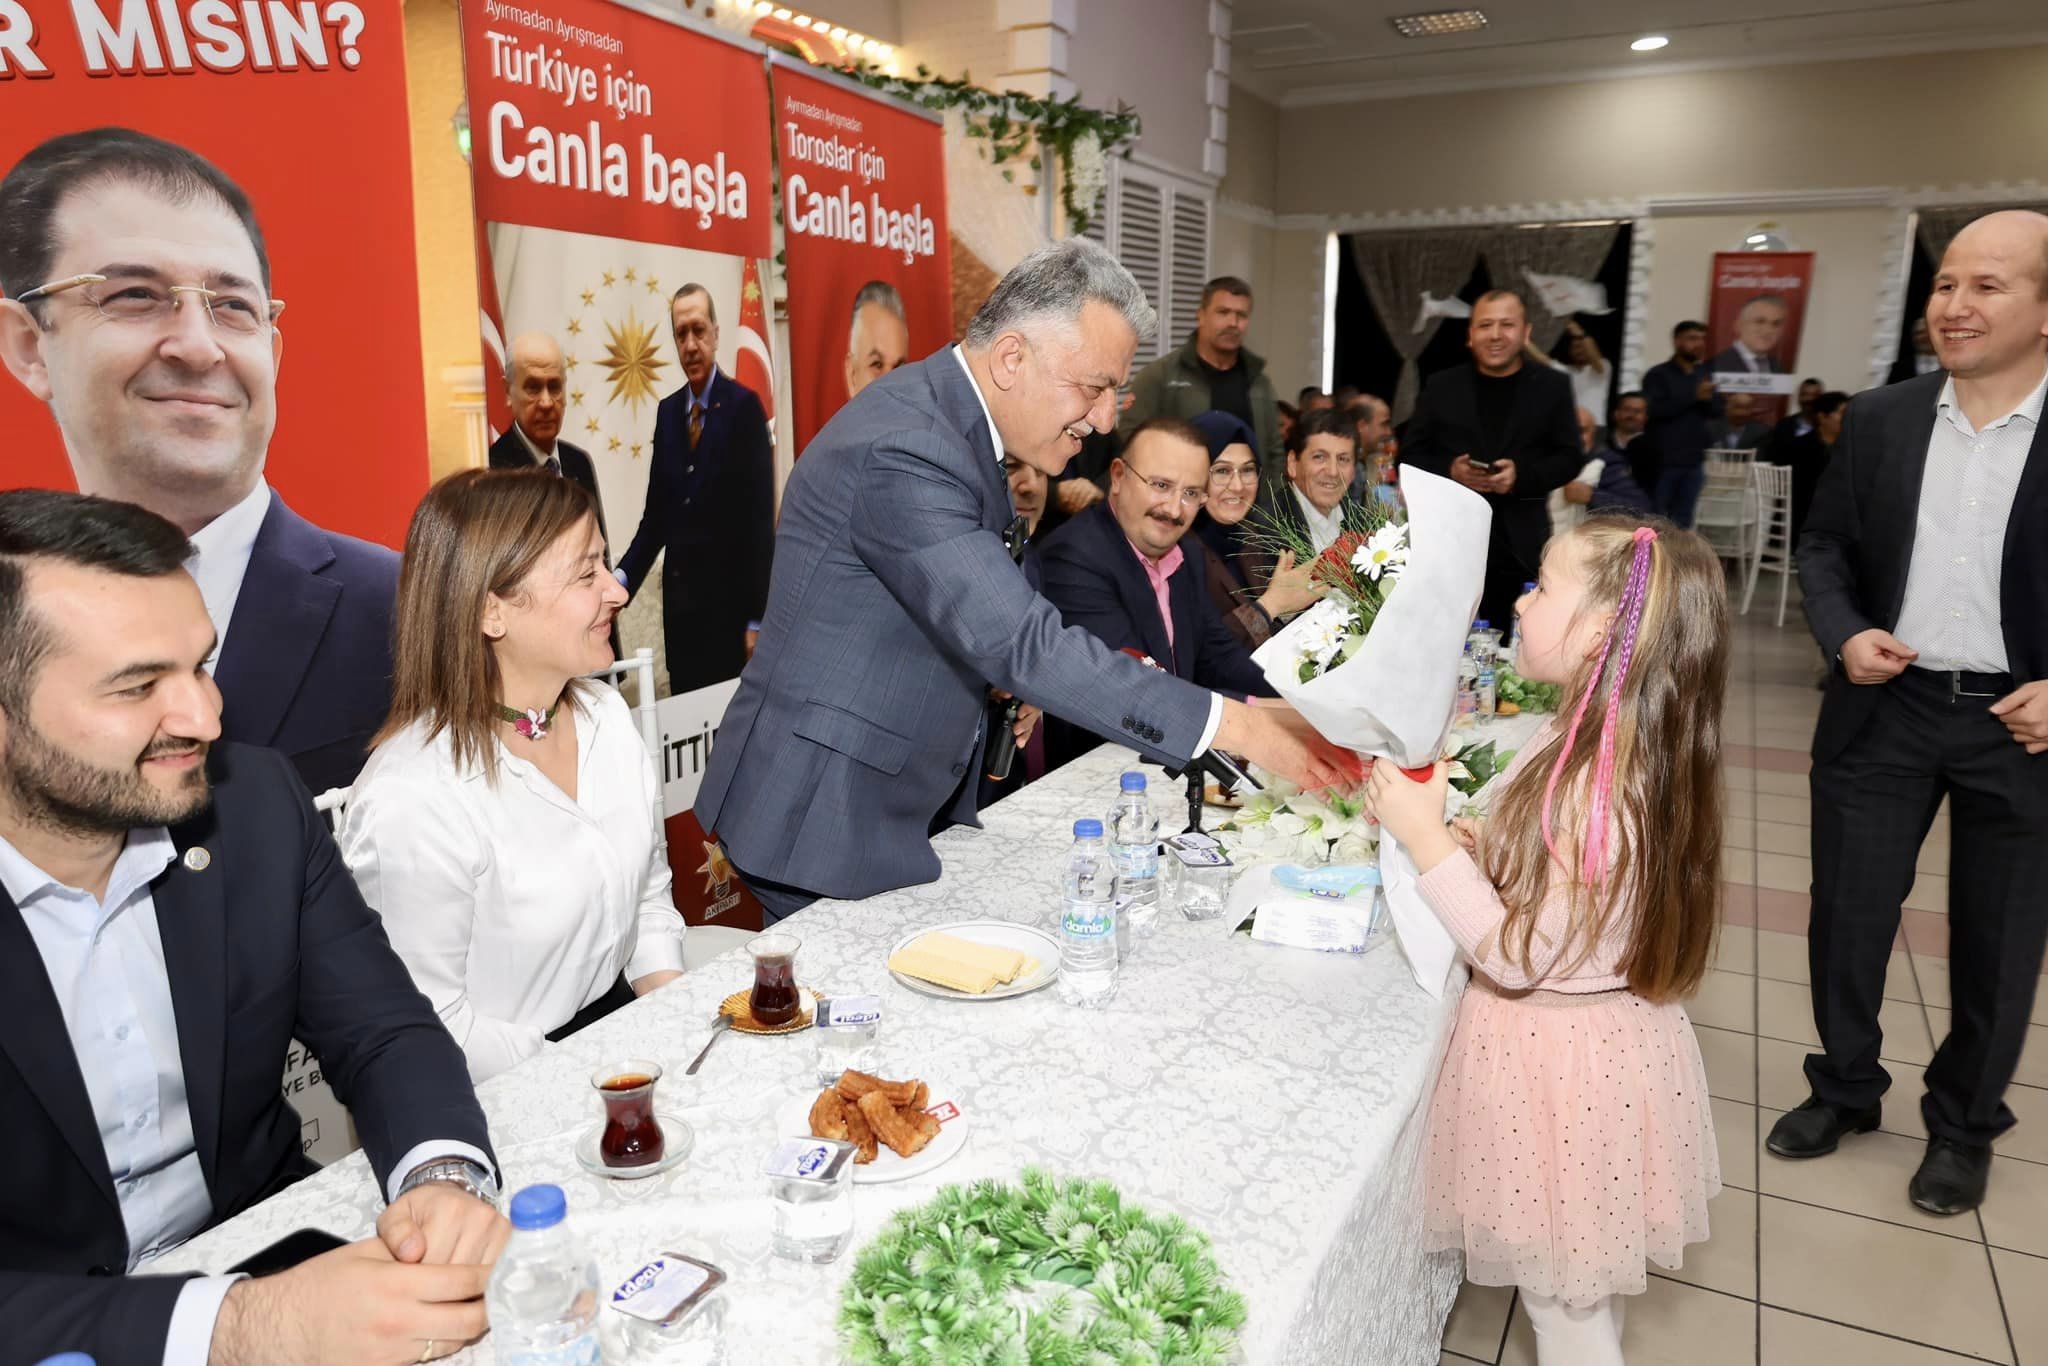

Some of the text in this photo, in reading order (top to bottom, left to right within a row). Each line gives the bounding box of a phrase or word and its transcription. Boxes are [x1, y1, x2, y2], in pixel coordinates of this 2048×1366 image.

[72, 0, 366, 72] MISIN?
[486, 0, 623, 54] Ayırmadan Ayrışmadan
[486, 30, 651, 119] Türkiye için
[489, 101, 747, 230] Canla başla
[786, 122, 885, 185] Toroslar için
[788, 174, 934, 265] Canla başla
